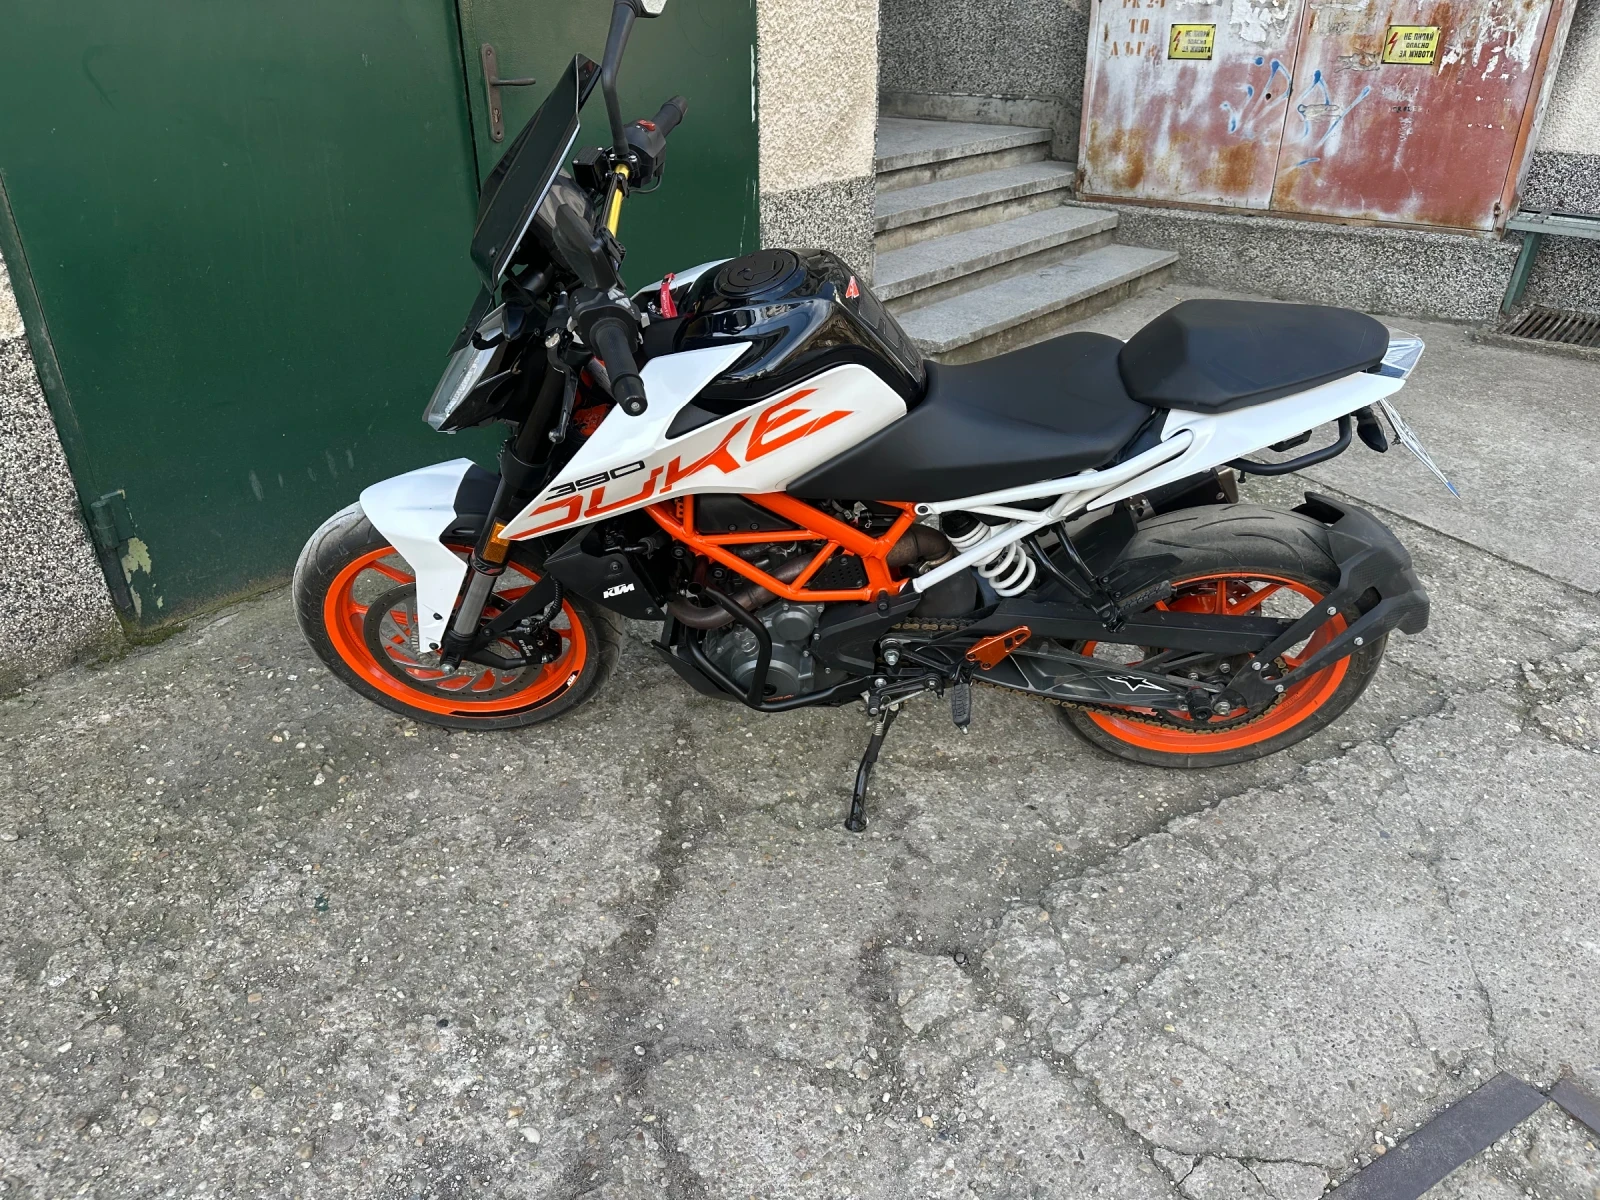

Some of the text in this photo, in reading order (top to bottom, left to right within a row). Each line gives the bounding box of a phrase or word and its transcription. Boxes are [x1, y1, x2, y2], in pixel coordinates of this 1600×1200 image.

[1404, 32, 1412, 40] НЕ
[1409, 50, 1434, 58] ЖИВОТА
[508, 388, 854, 540] DUKE
[544, 460, 646, 502] 390
[603, 583, 635, 599] KTM
[566, 673, 577, 687] KTM
